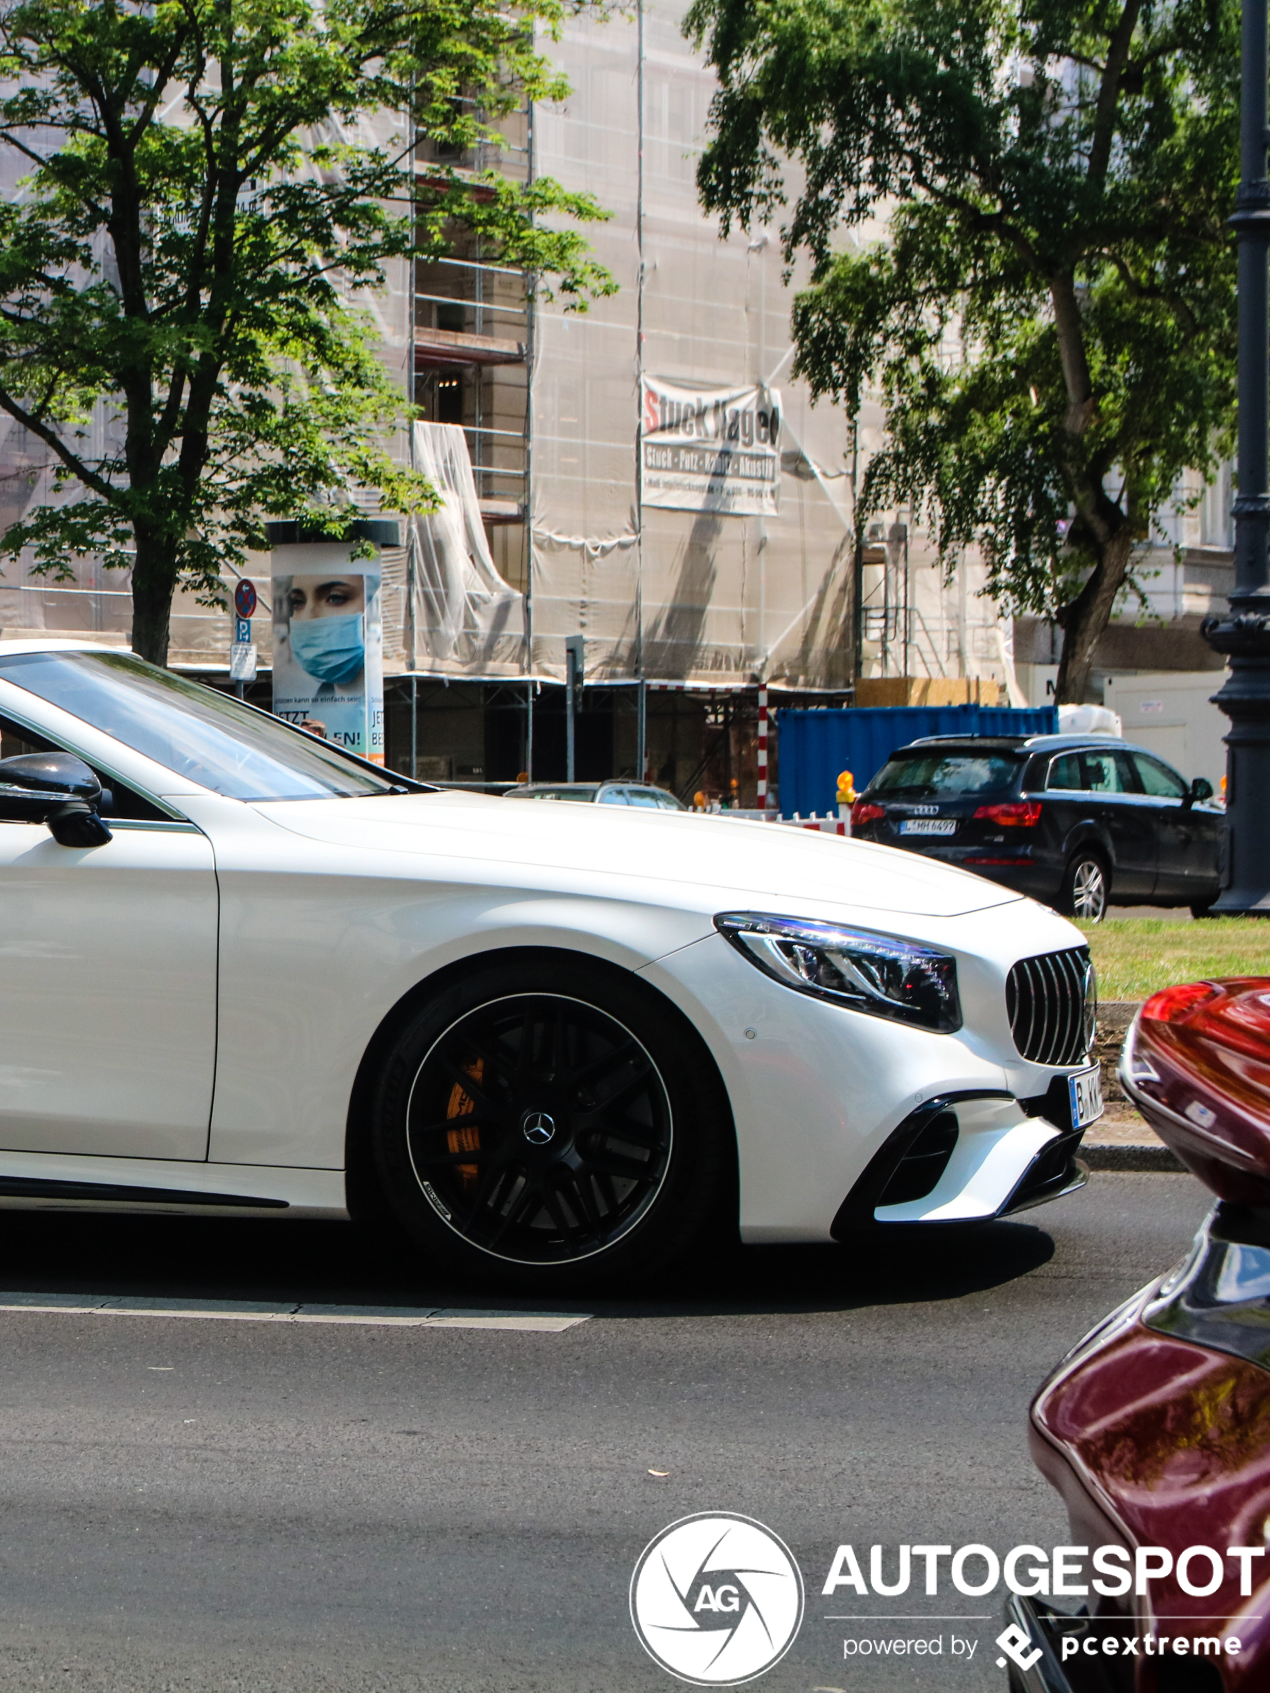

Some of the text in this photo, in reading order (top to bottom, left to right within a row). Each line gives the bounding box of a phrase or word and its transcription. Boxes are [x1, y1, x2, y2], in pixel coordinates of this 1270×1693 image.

[645, 390, 709, 438] Stuck
[646, 446, 672, 469] Stuck
[680, 449, 698, 471] Putz
[740, 455, 774, 479] Akustik
